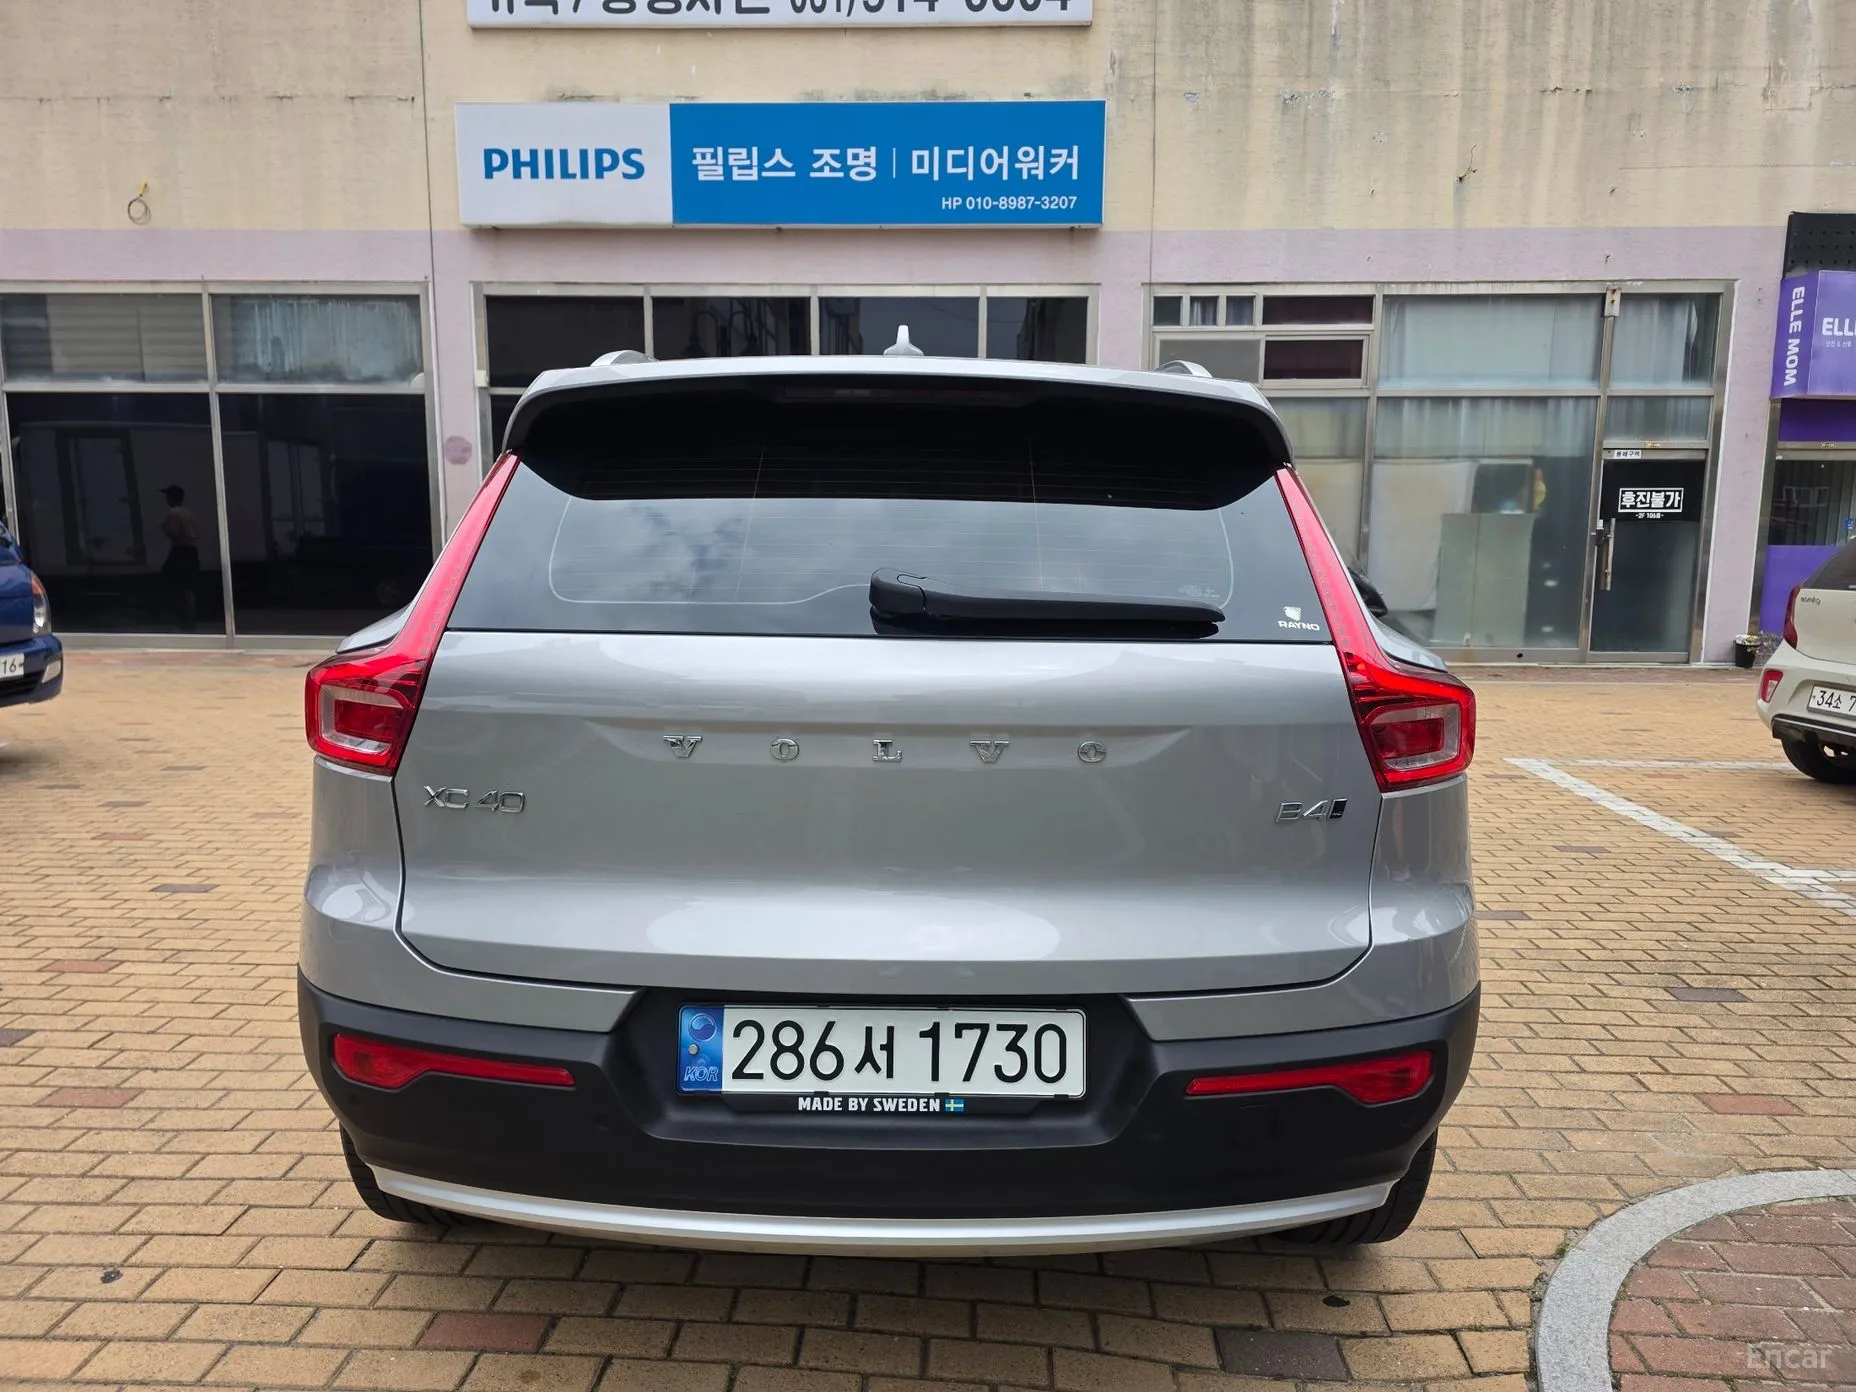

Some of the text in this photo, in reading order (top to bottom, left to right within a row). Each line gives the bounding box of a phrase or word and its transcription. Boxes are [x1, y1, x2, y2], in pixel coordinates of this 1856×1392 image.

[483, 147, 645, 181] PHILIPS
[692, 145, 1079, 182] 필립스 조명 미디어워커
[941, 195, 1078, 210] HP 010-8987-3207
[1783, 286, 1806, 386] ELLE MOM
[1821, 317, 1856, 336] ELL
[1621, 491, 1681, 508] 후진불가
[1277, 620, 1320, 631] RAYNO
[1816, 690, 1842, 709] 34소
[662, 734, 1107, 764] VOLVO
[1274, 800, 1328, 824] B4
[731, 1019, 1067, 1084] 286서 1730
[683, 1065, 719, 1082] KOR
[798, 1097, 940, 1112] MADE BY SWEDEN
